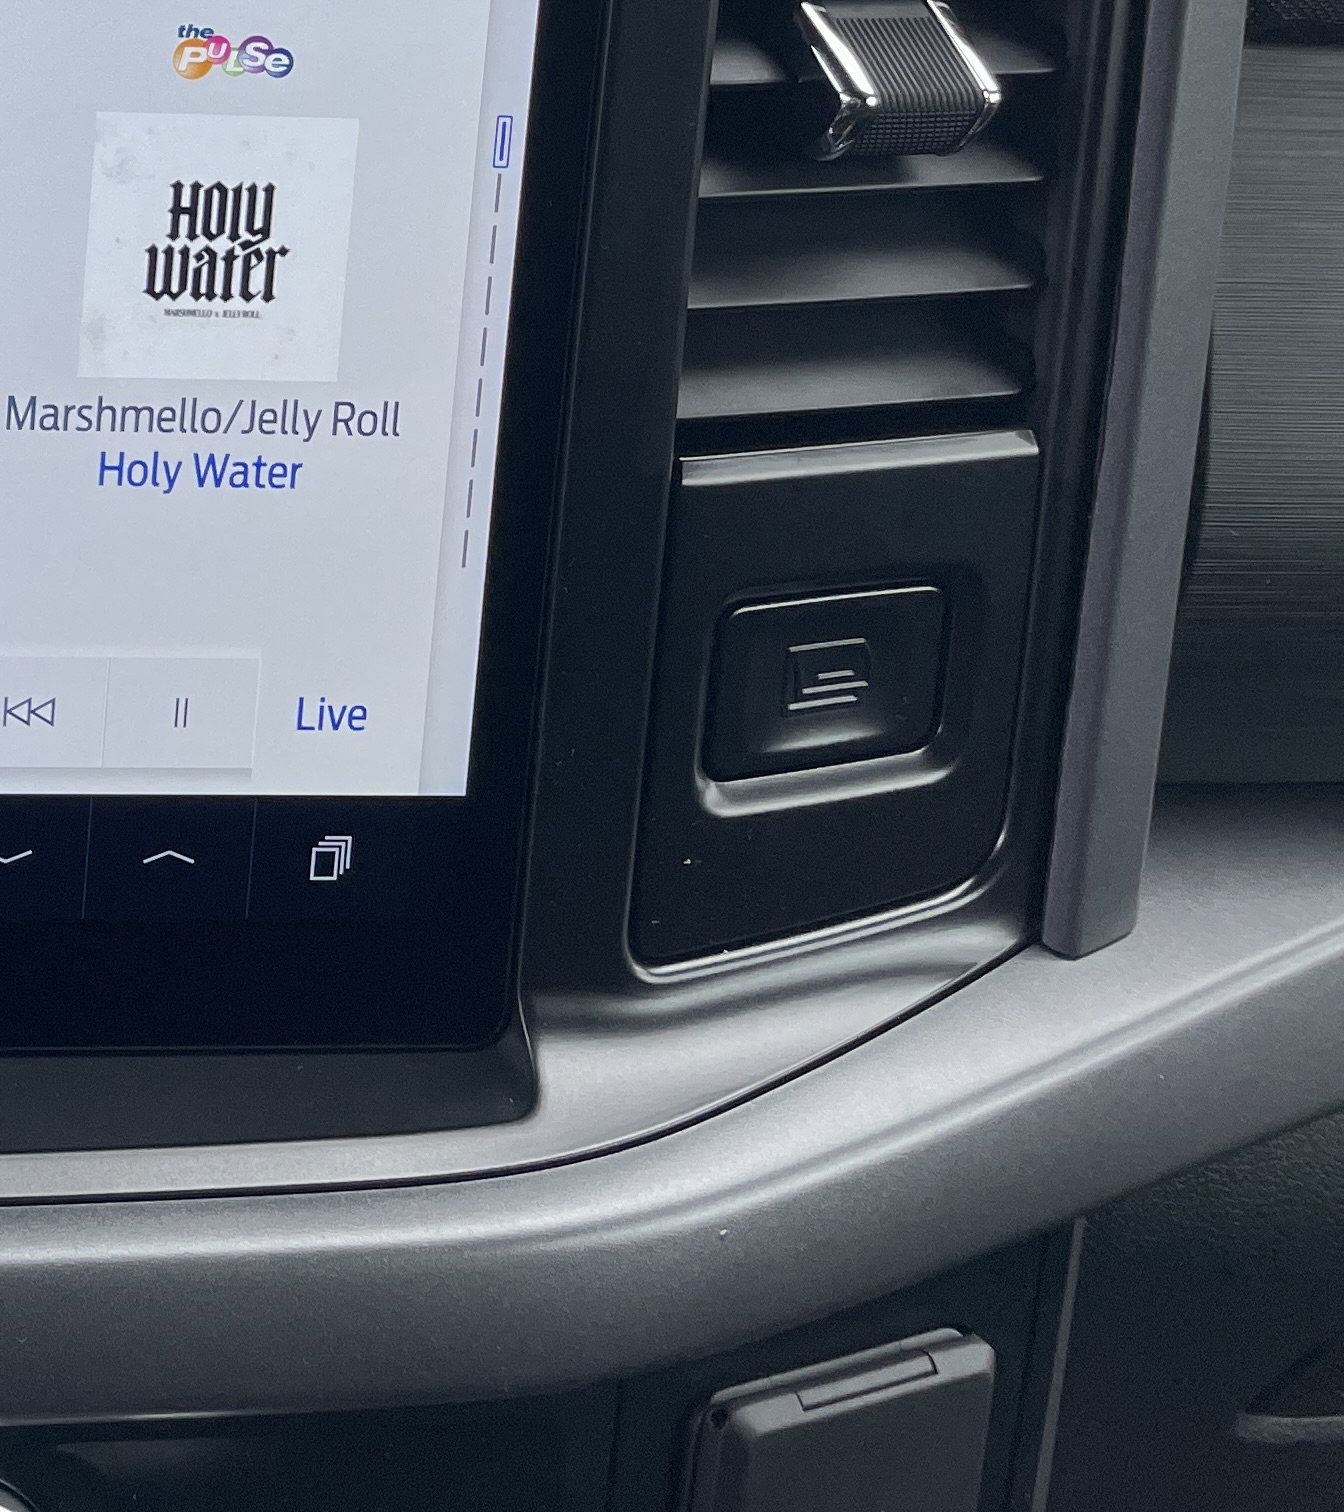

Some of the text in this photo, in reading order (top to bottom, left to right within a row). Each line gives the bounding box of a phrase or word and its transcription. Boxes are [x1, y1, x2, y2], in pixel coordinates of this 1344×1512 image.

[177, 24, 214, 39] the
[6, 395, 399, 442] Marshmello/Jelly Roll
[99, 451, 303, 494] Holy Water
[297, 697, 367, 731] Live
